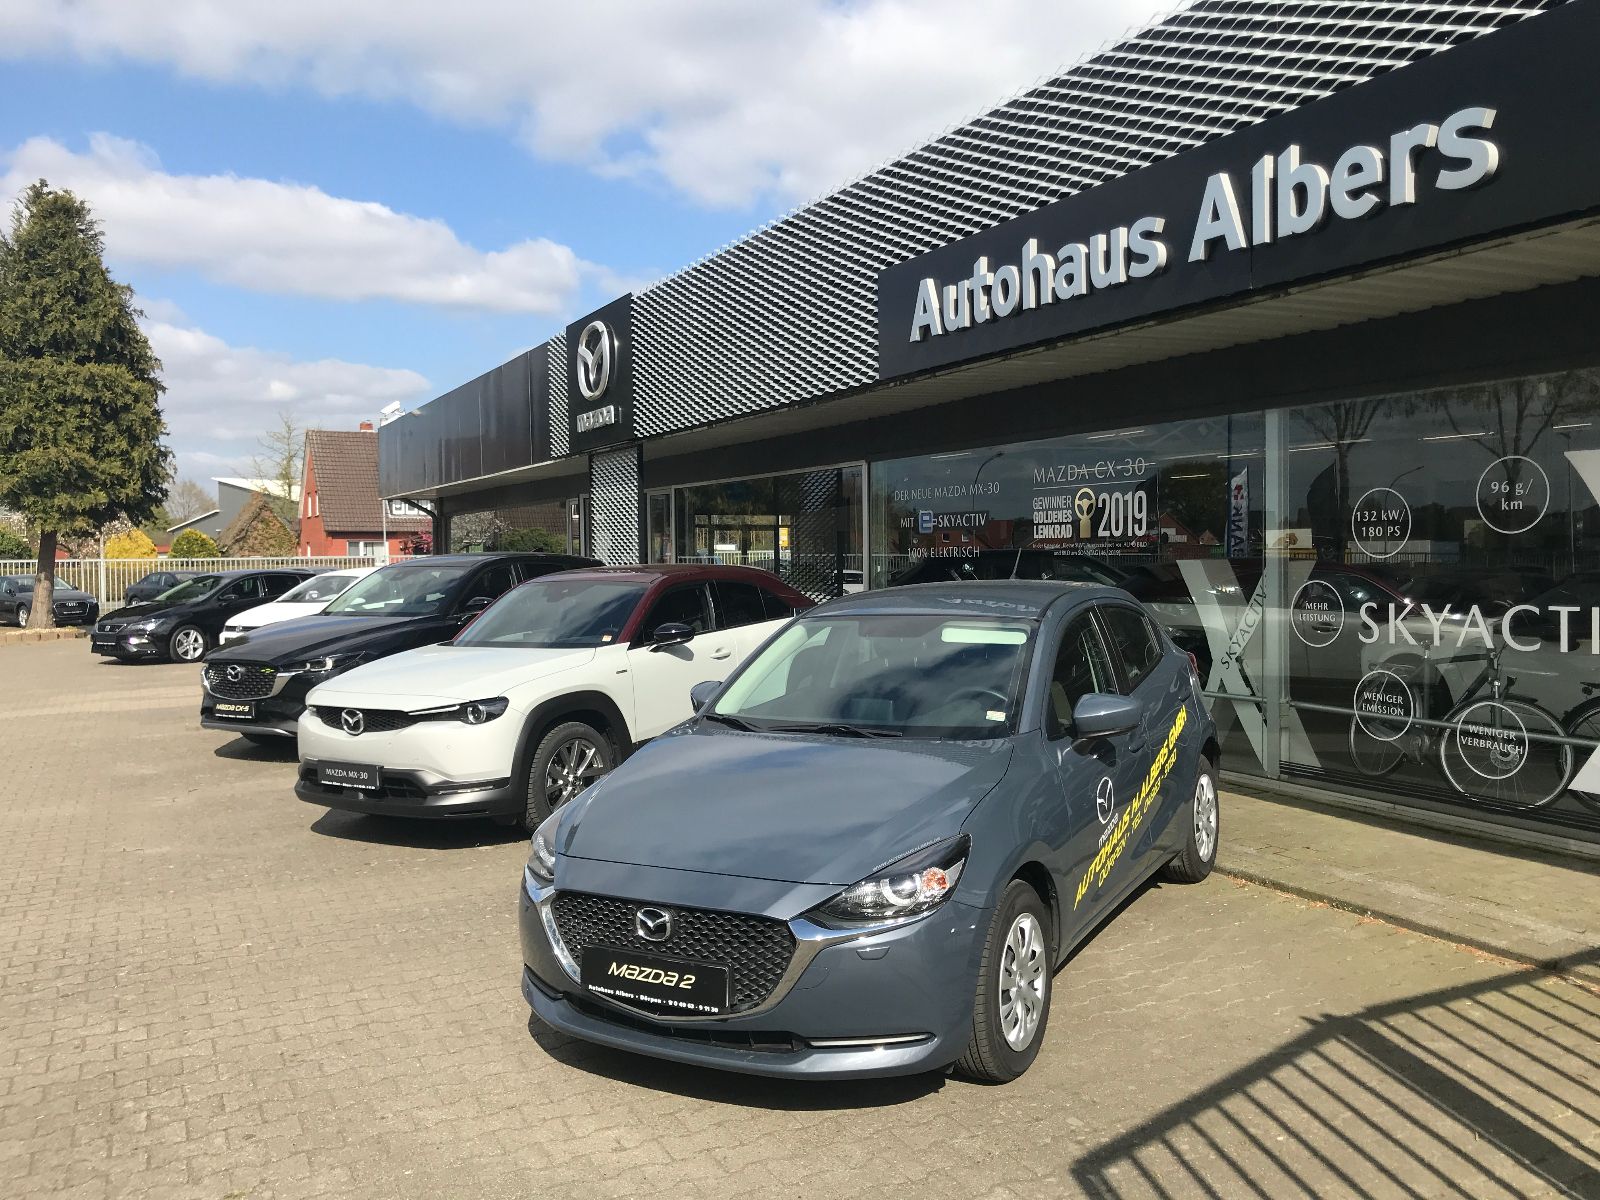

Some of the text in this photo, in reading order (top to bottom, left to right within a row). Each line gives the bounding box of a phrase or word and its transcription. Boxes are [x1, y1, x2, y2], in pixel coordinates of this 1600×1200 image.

[909, 106, 1500, 343] Autohaus Albers
[1033, 463, 1089, 484] MAZDA
[894, 481, 1000, 501] DER NEUE MAZDA MX-30
[1490, 480, 1510, 494] 96
[1032, 495, 1073, 510] GEWINNER
[1501, 497, 1523, 511] km
[1033, 509, 1073, 524] GOLDENES
[1097, 490, 1147, 537] 2019
[1355, 510, 1377, 522] 132
[900, 517, 915, 529] MIT
[1033, 524, 1073, 539] LENKRAD
[1361, 525, 1401, 538] 180 PS
[907, 546, 980, 559] 100% ELEKTRISCH
[1305, 601, 1329, 612] MEHR
[1299, 612, 1337, 623] LEISTUNG
[1221, 584, 1267, 670] SKYACTIV
[1357, 601, 1600, 655] SKYACTI
[1363, 691, 1404, 705] WENIGER
[1362, 703, 1405, 717] EMISSION
[1468, 724, 1516, 742] WENIGER
[1460, 735, 1524, 756] VERBRAUCH
[325, 768, 368, 780] MAZDA MX-30
[1073, 805, 1131, 912] AUTOHAUS
[679, 974, 696, 990] 2
[588, 984, 614, 995] Autohaus
[615, 990, 634, 999] Albers
